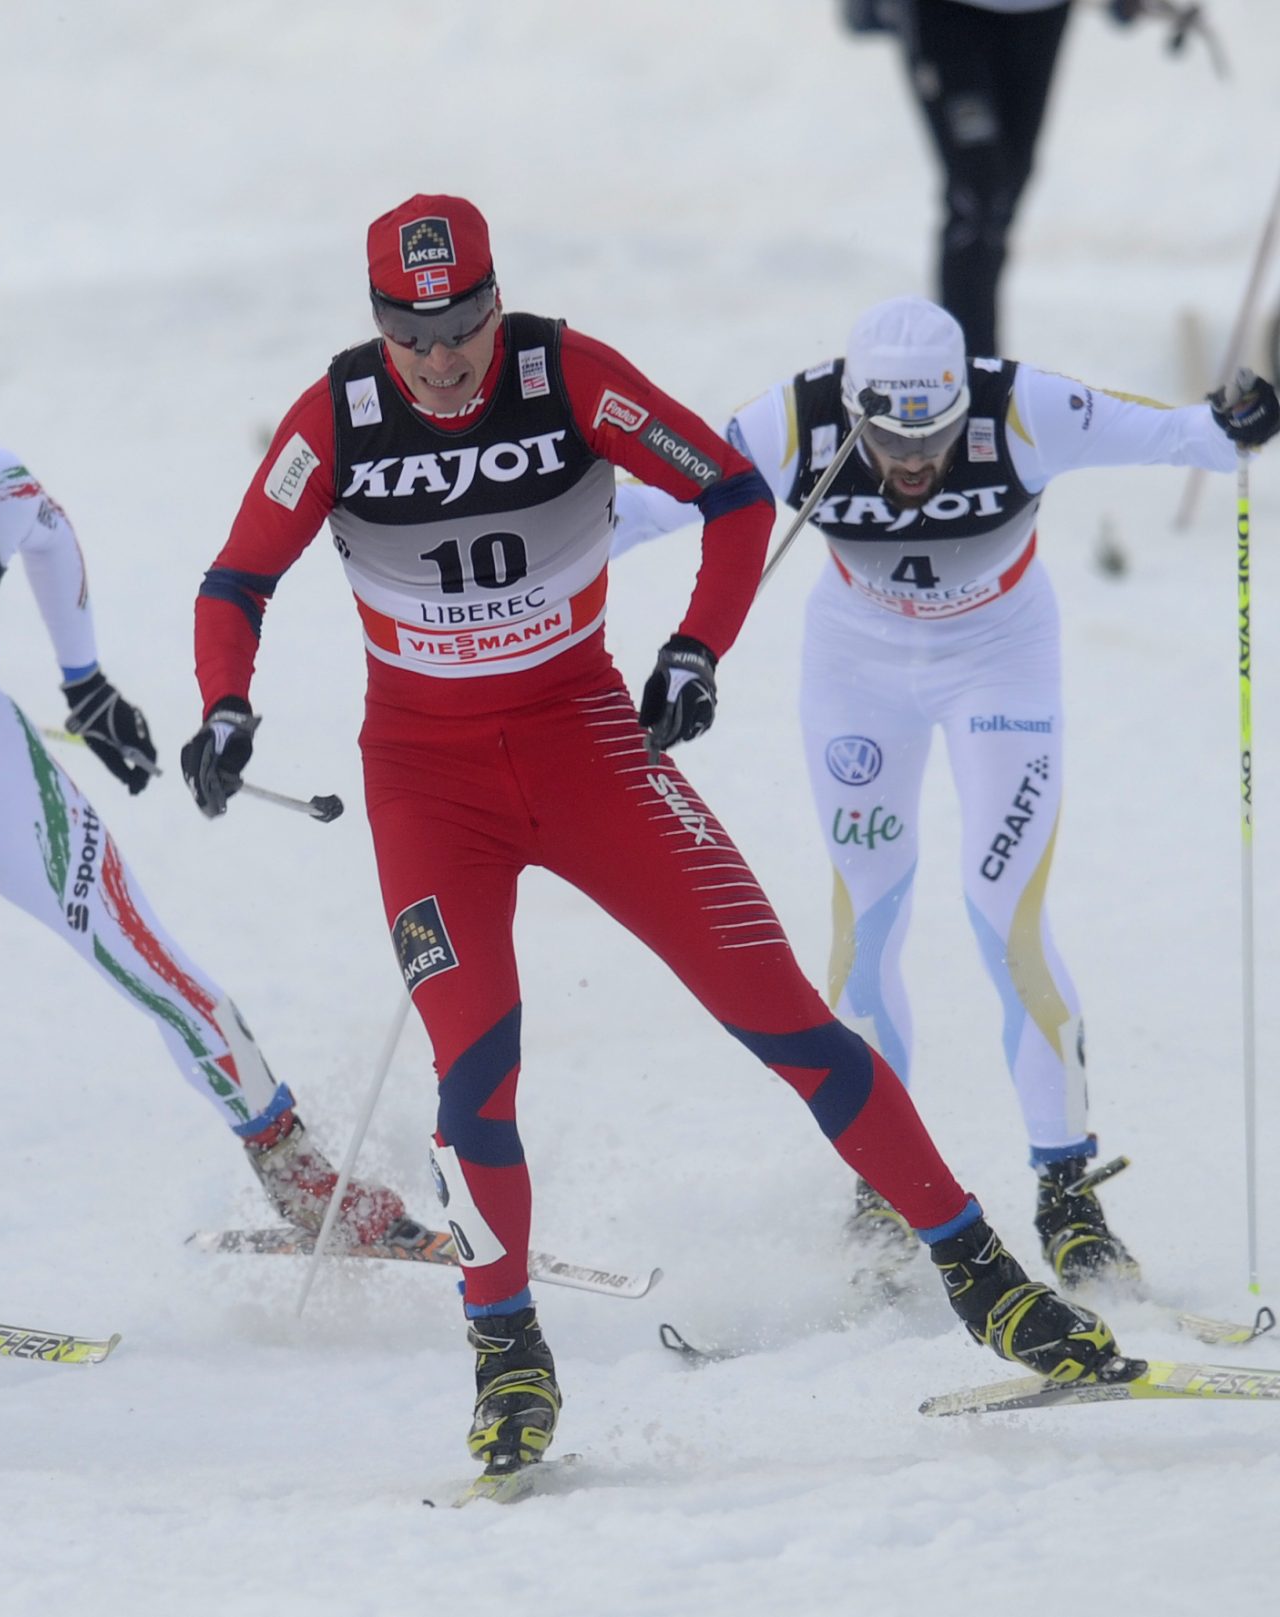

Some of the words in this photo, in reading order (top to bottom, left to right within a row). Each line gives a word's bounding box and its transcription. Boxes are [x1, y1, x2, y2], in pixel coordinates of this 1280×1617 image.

[407, 247, 450, 264] AKER
[278, 449, 314, 498] TERRA
[342, 429, 566, 505] KAJOT
[420, 532, 527, 594] 10
[891, 555, 940, 589] 4
[420, 586, 546, 625] LIBEREC
[408, 612, 562, 661] VIESSMANN
[970, 715, 1052, 733] Folksam
[980, 776, 1043, 883] CRAFT
[403, 946, 445, 985] AKER
